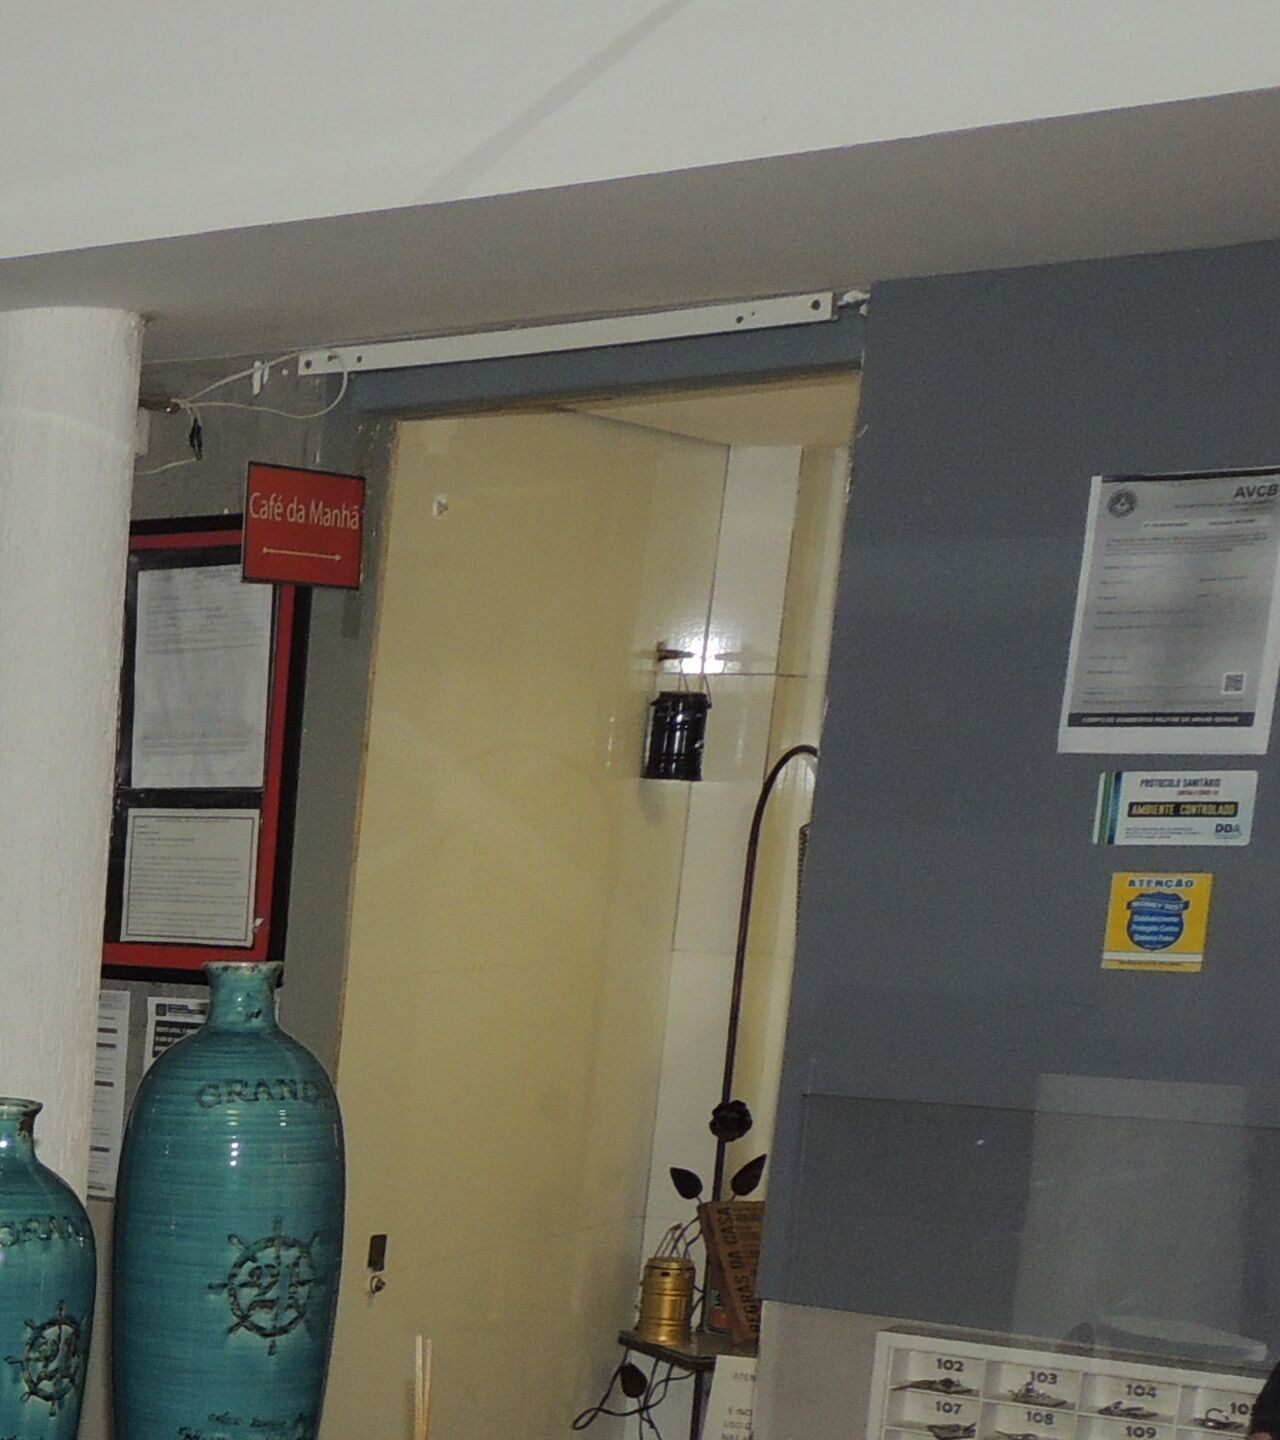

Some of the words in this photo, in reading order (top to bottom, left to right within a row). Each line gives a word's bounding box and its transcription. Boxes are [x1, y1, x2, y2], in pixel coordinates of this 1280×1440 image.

[1234, 484, 1279, 499] AVCB
[249, 491, 284, 521] Café
[286, 496, 305, 523] da
[309, 499, 359, 529] Manhã
[1131, 803, 1176, 816] AMBIENTE
[1179, 803, 1236, 816] CONTROLADO
[1128, 878, 1194, 889] ATENÇÃO
[936, 1358, 964, 1372] 102
[1030, 1370, 1058, 1385] 103
[1126, 1383, 1157, 1398] 104
[935, 1401, 962, 1415] 107
[1026, 1411, 1054, 1425] 108
[1126, 1425, 1157, 1439] 109
